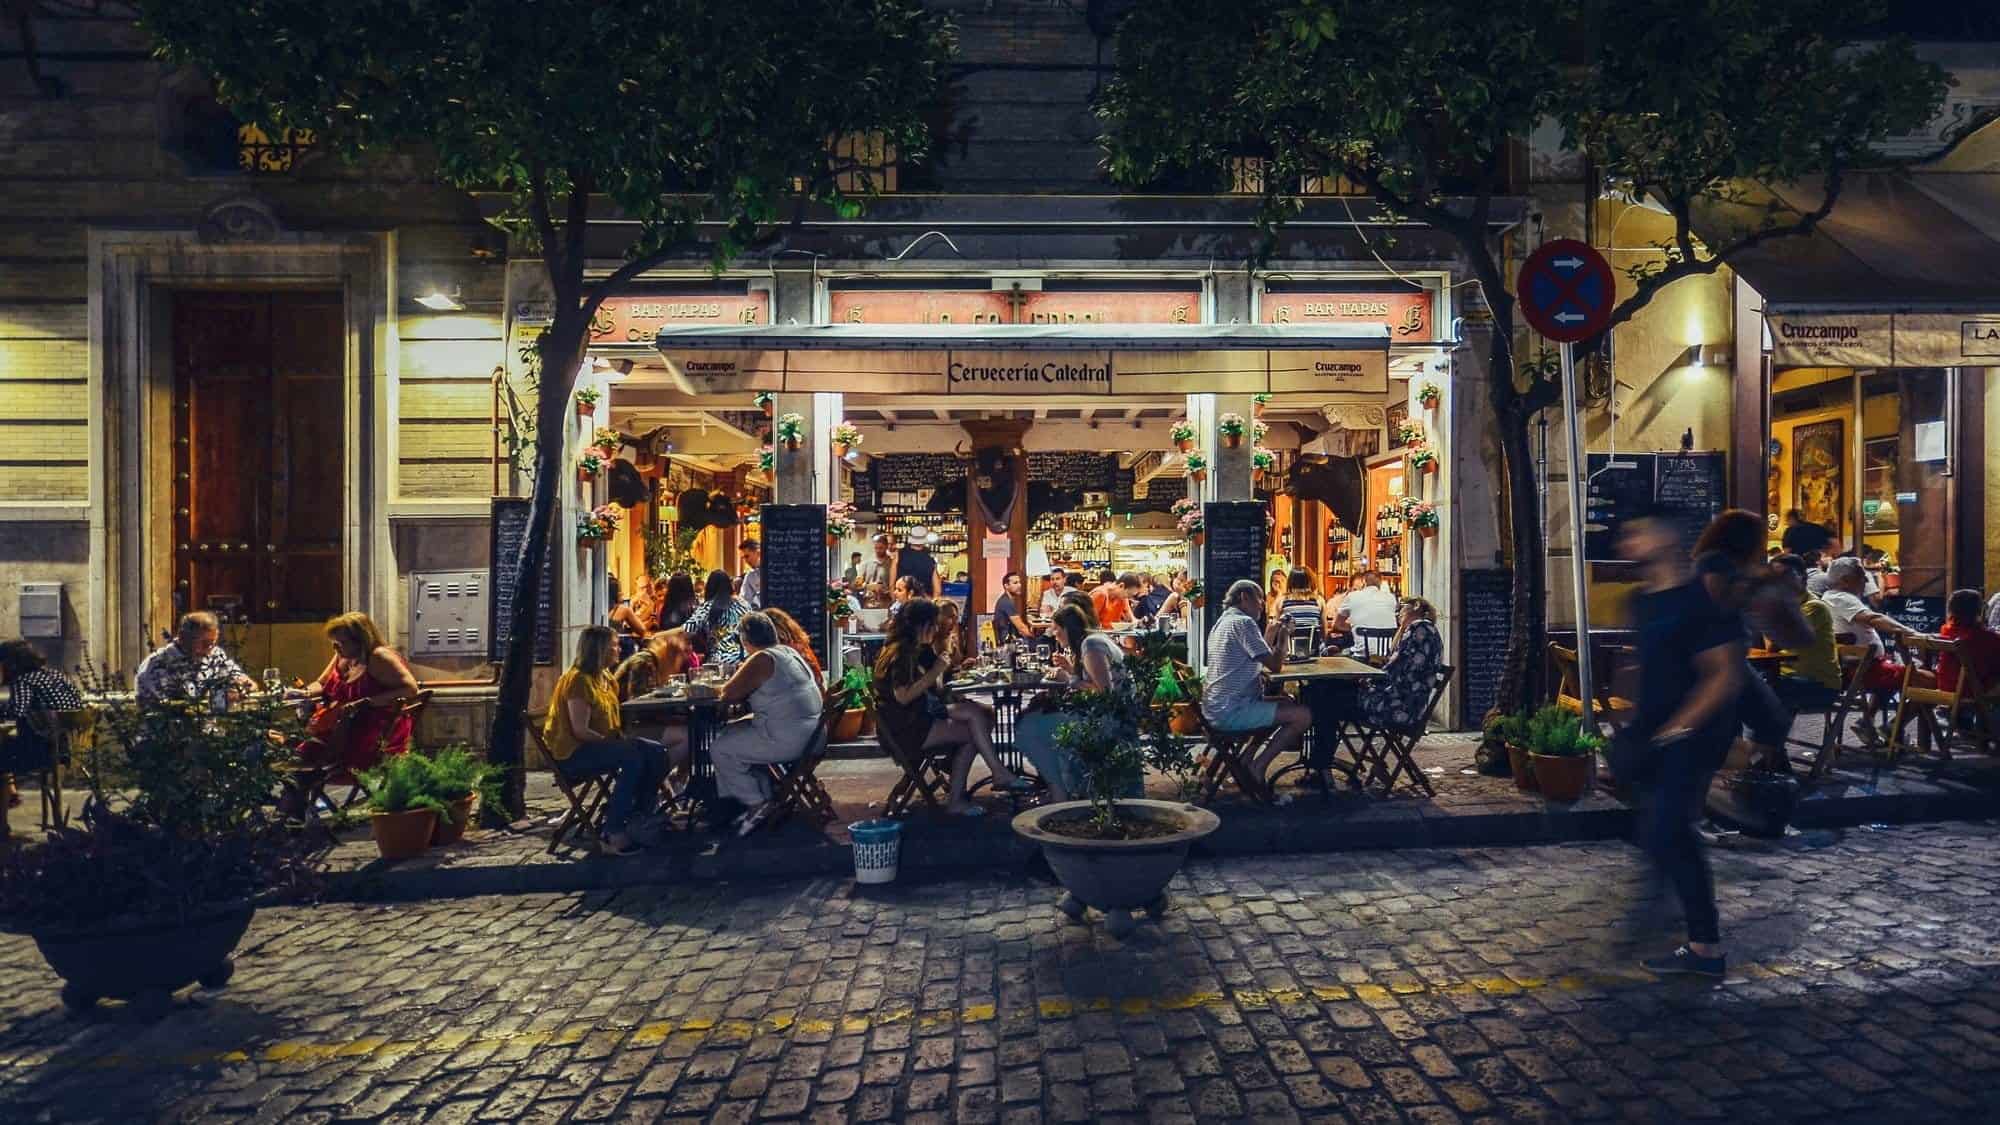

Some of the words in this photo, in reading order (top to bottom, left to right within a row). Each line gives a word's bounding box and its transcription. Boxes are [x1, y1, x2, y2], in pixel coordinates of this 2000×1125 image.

[631, 303, 664, 317] BAR
[670, 303, 720, 317] TAPAS
[1305, 302, 1336, 316] BAR
[1340, 302, 1389, 316] TAPAS
[1782, 323, 1858, 341] Cruzcampo
[686, 361, 736, 372] Cruzcampo
[950, 362, 1039, 383] Cervecería
[1041, 363, 1111, 383] Catedral
[1315, 361, 1362, 372] Cruzcampo
